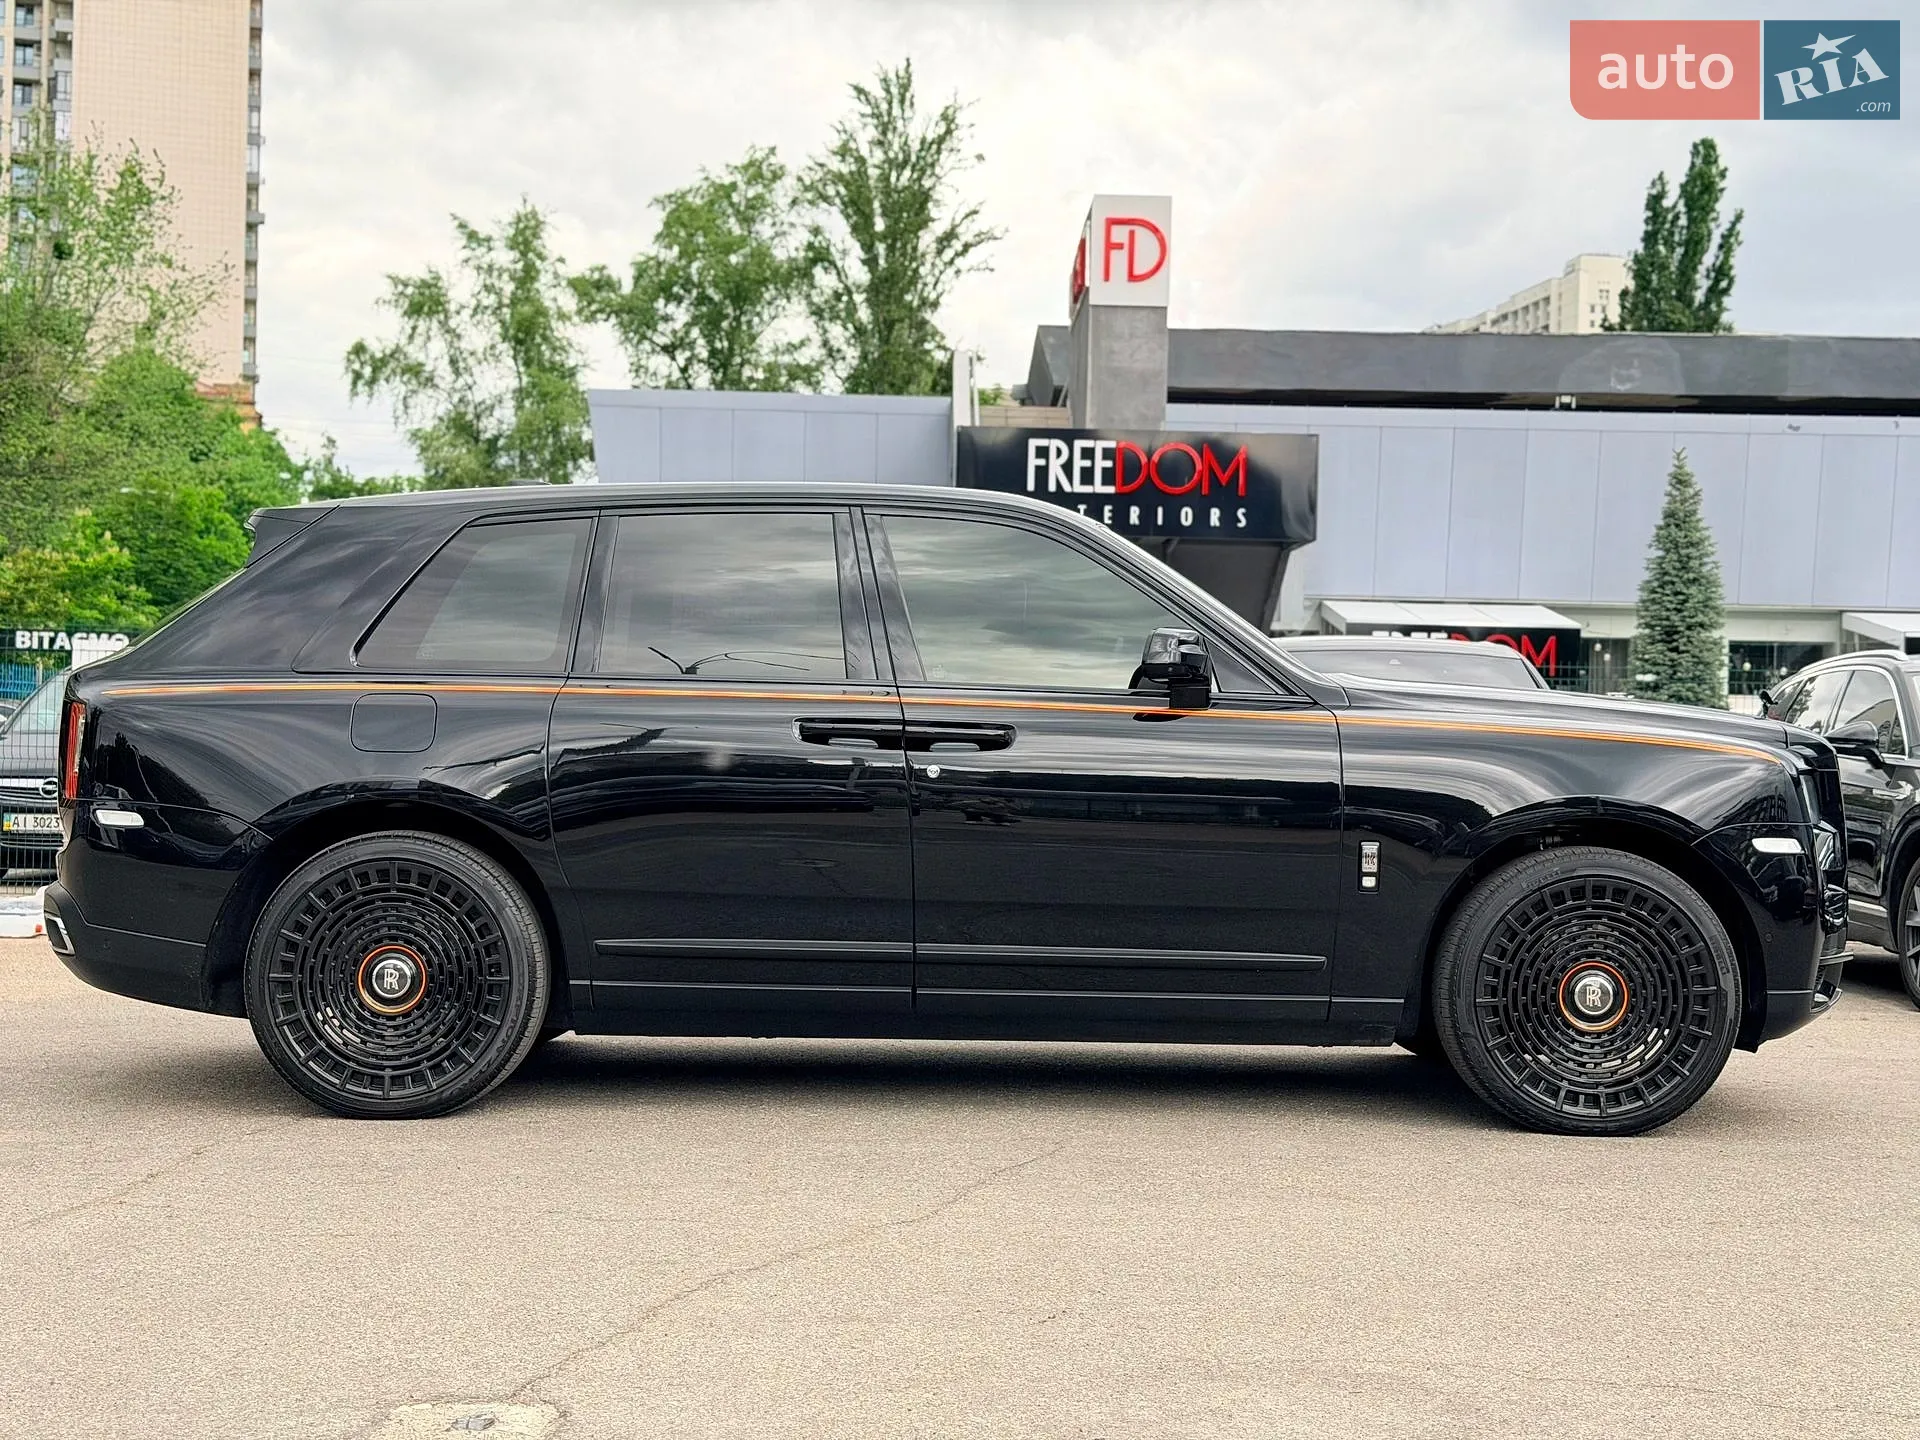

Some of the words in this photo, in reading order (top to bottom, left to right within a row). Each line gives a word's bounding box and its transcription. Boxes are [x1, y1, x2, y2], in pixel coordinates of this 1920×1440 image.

[1103, 217, 1167, 282] FD
[1026, 438, 1248, 497] FREEDOM
[1077, 504, 1247, 528] TERIORS
